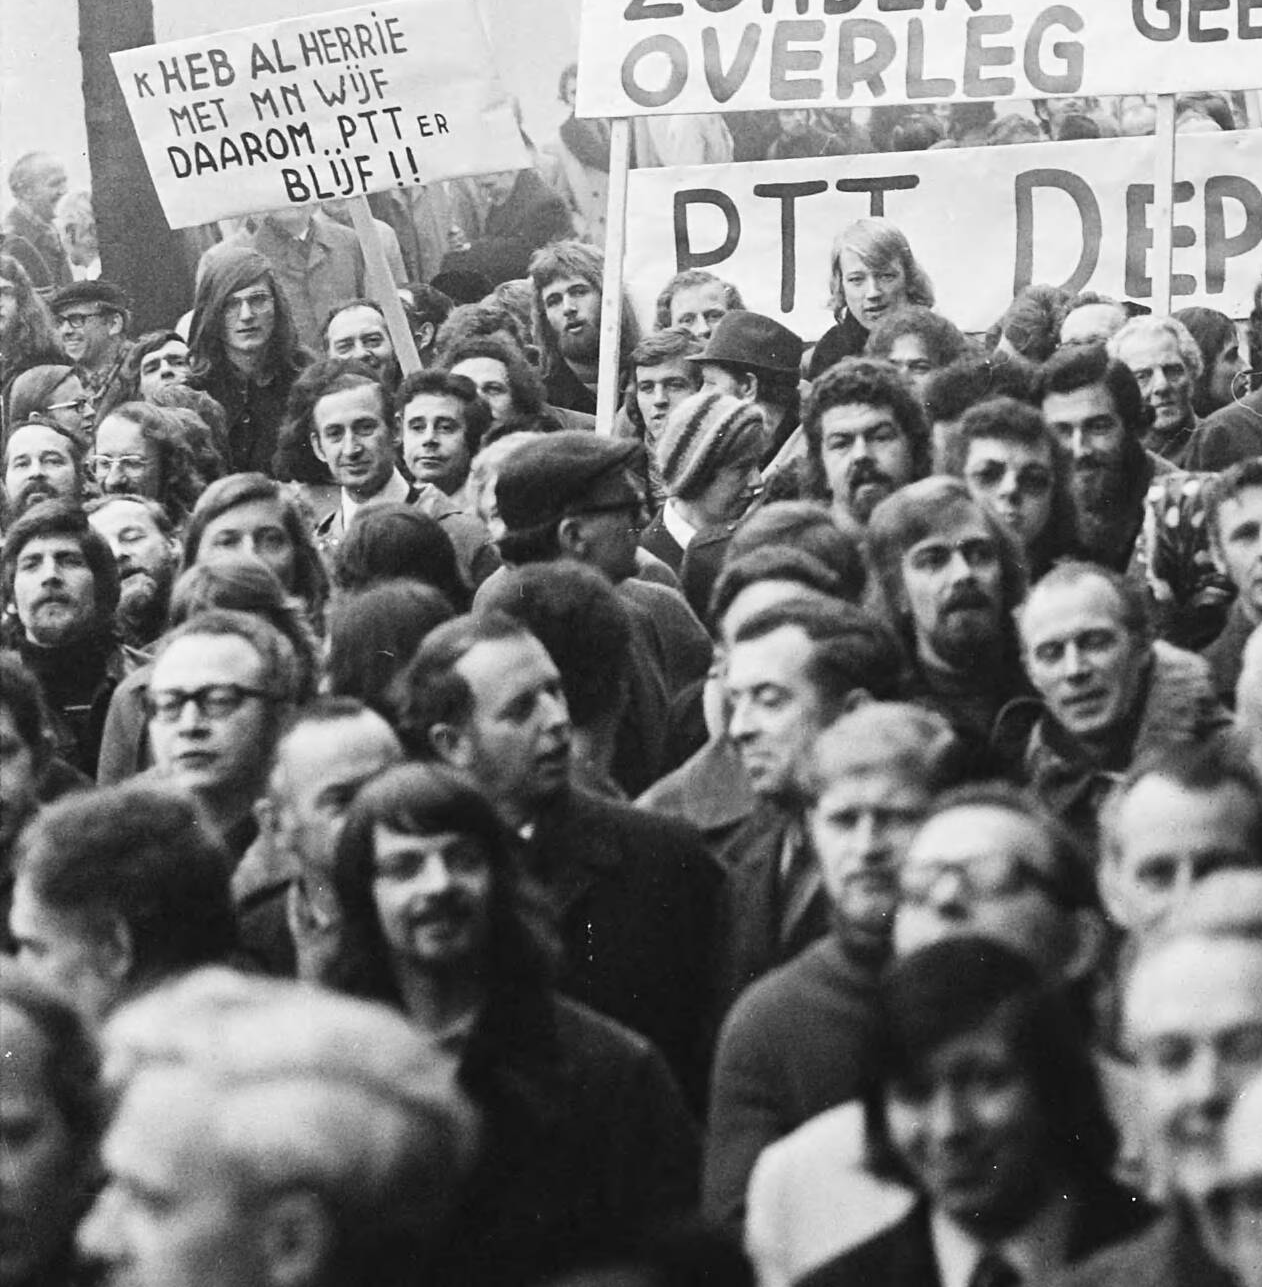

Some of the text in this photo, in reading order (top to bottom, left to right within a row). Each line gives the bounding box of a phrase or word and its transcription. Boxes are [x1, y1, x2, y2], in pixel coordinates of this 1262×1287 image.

[158, 48, 236, 94] HEB
[250, 39, 297, 80] AL
[621, 4, 1085, 107] OVERLEG
[168, 98, 230, 137] MET
[250, 83, 307, 122] MN
[673, 174, 920, 314] PTT
